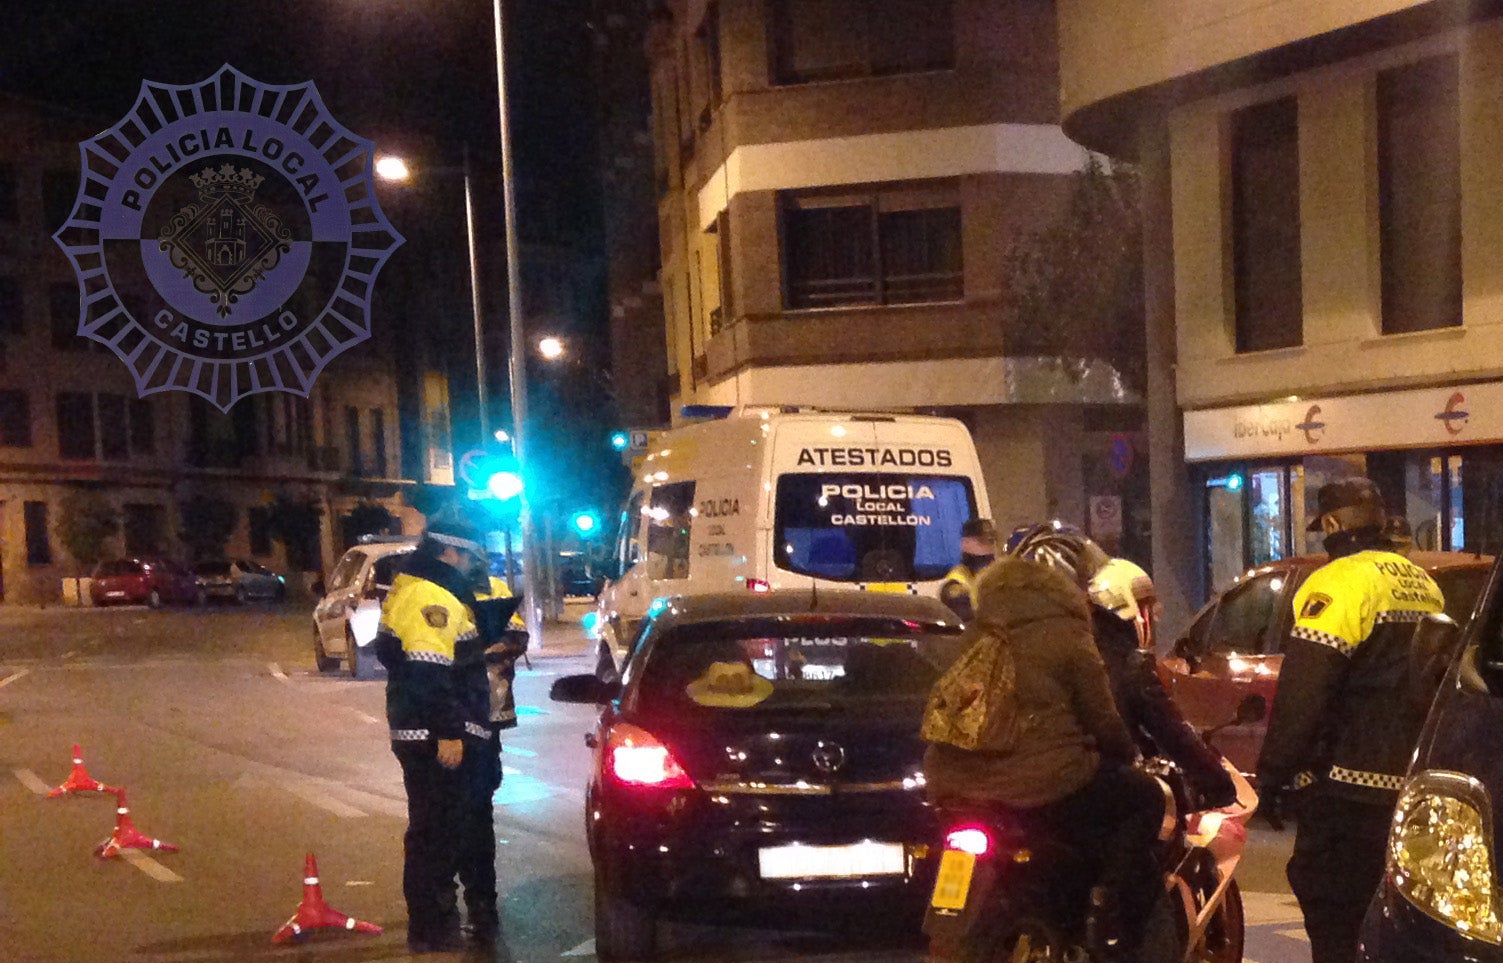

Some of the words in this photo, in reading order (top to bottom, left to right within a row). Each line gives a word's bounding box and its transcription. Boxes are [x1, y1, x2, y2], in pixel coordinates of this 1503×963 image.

[797, 448, 953, 468] ATESTADOS
[821, 484, 935, 500] POLICIA
[856, 500, 906, 513] LOCAL
